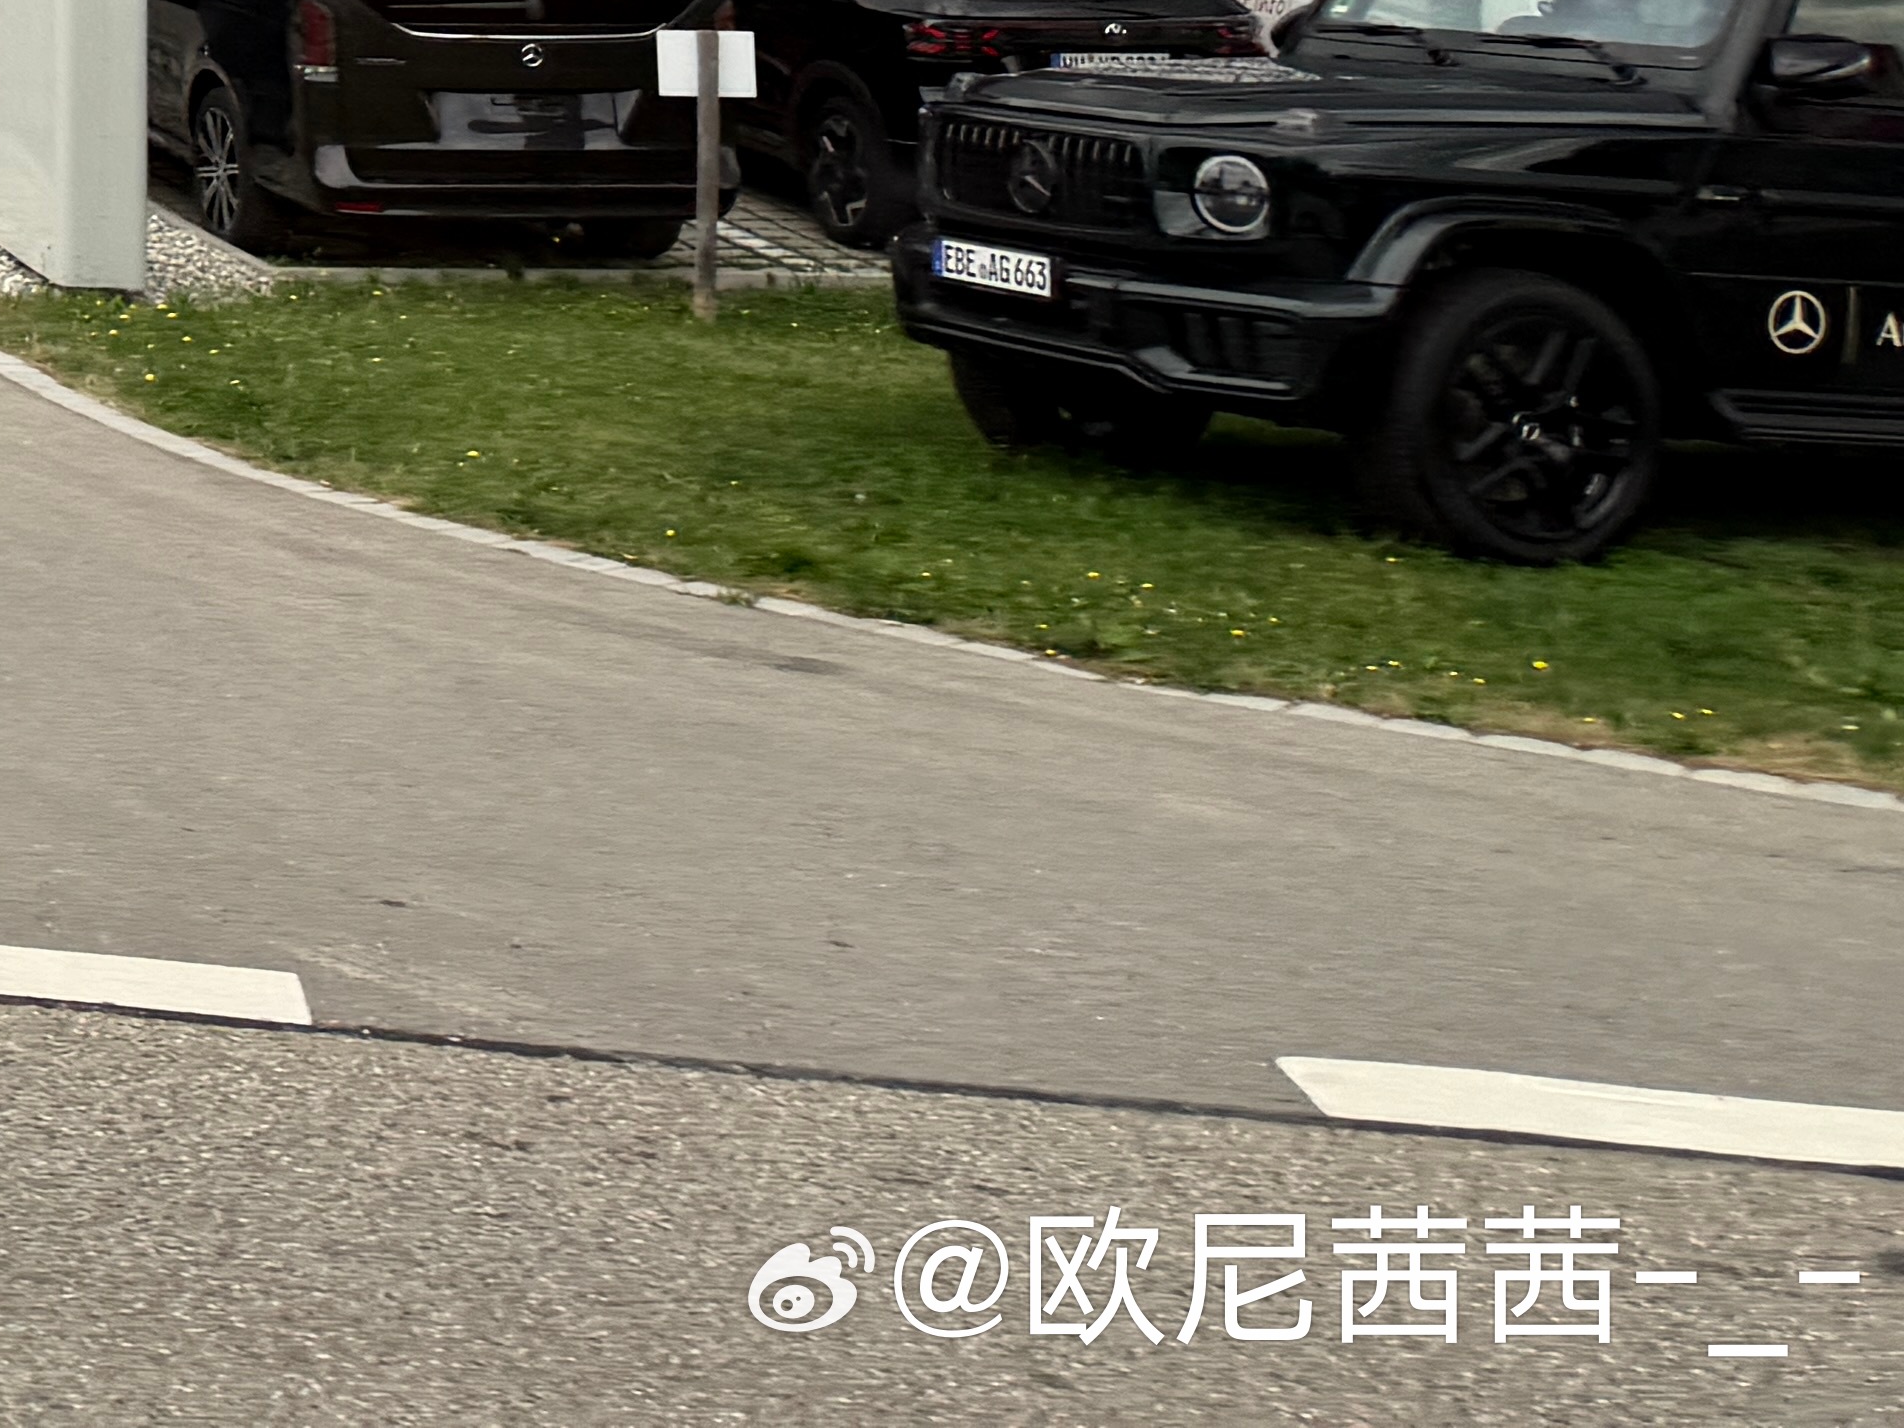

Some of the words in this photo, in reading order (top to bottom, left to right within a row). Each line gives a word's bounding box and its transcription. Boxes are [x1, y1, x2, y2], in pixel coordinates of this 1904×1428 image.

[944, 244, 976, 278] EBE
[988, 252, 1011, 284] AG
[1014, 257, 1048, 291] 663
